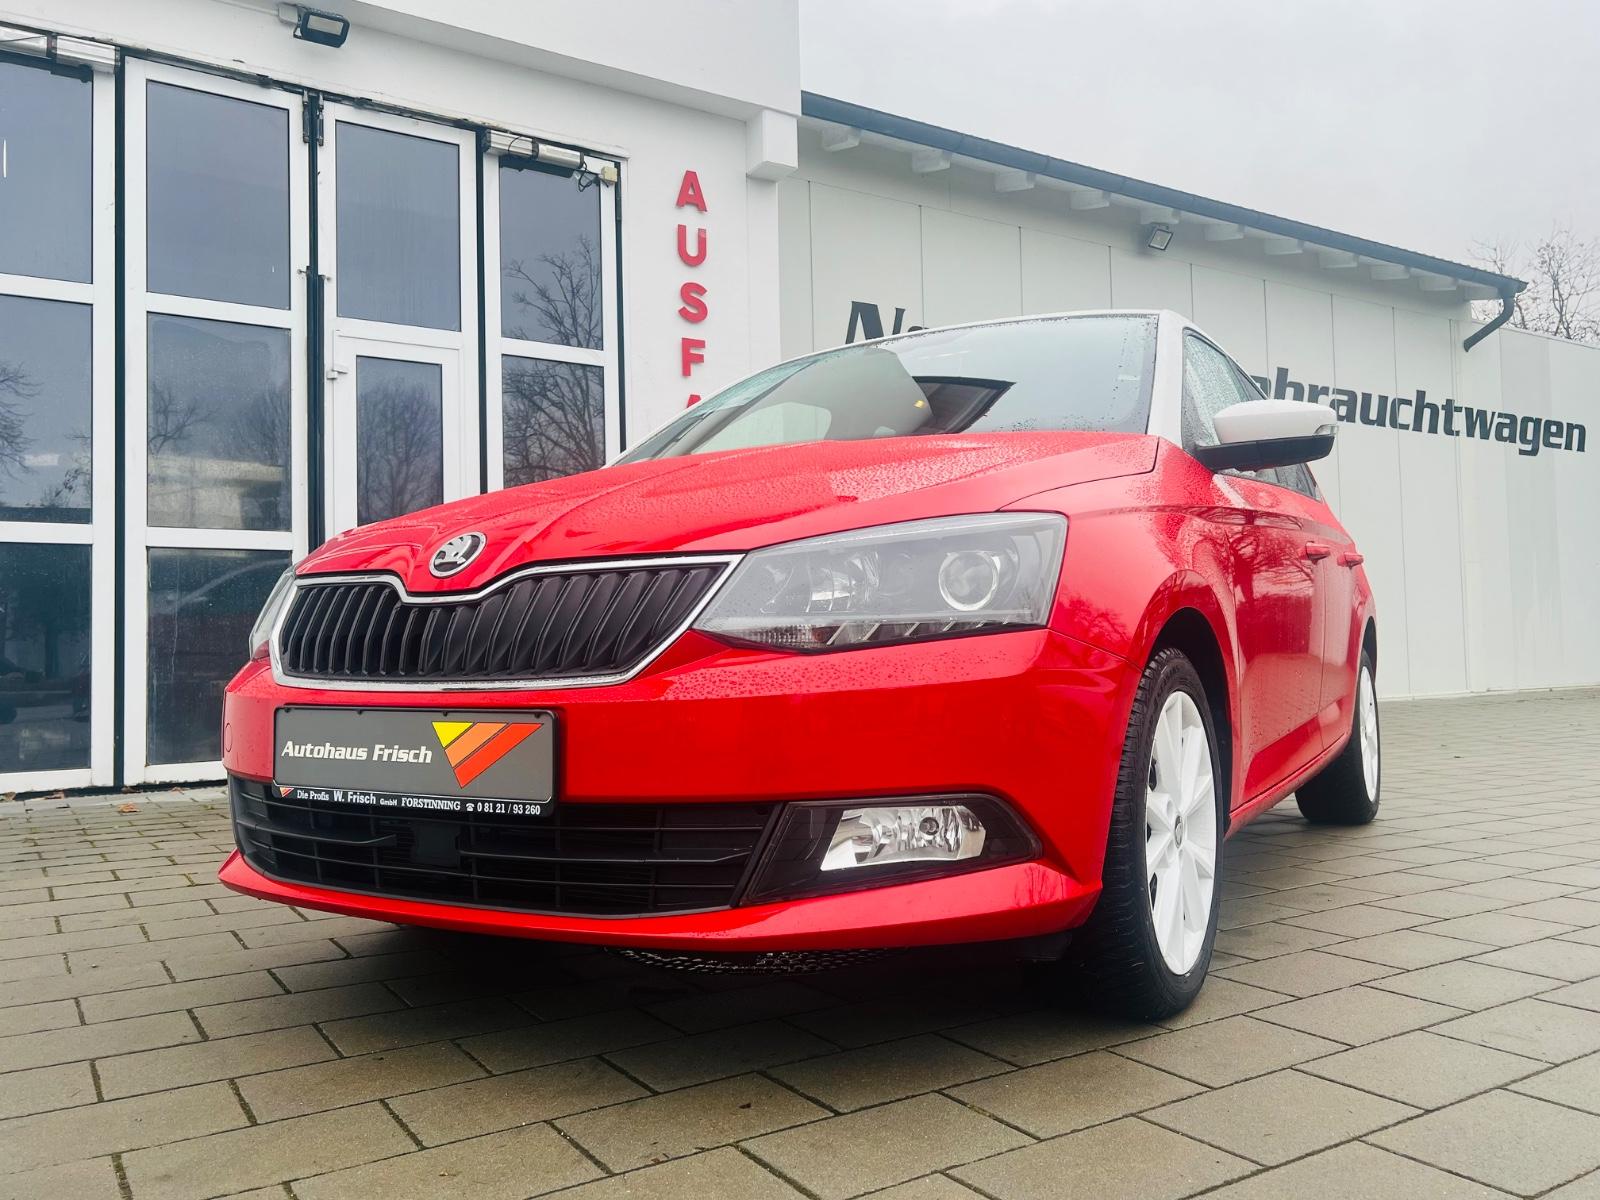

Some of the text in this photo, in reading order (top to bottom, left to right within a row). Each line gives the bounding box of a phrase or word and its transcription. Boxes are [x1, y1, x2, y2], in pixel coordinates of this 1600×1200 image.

[281, 740, 433, 763] Autohaus Frisch
[297, 790, 308, 799] Die
[309, 791, 330, 801] Profis
[333, 790, 345, 802] W.
[347, 792, 376, 804] Frisch
[379, 798, 398, 806] GmbH
[401, 797, 461, 811] FORSTINNING
